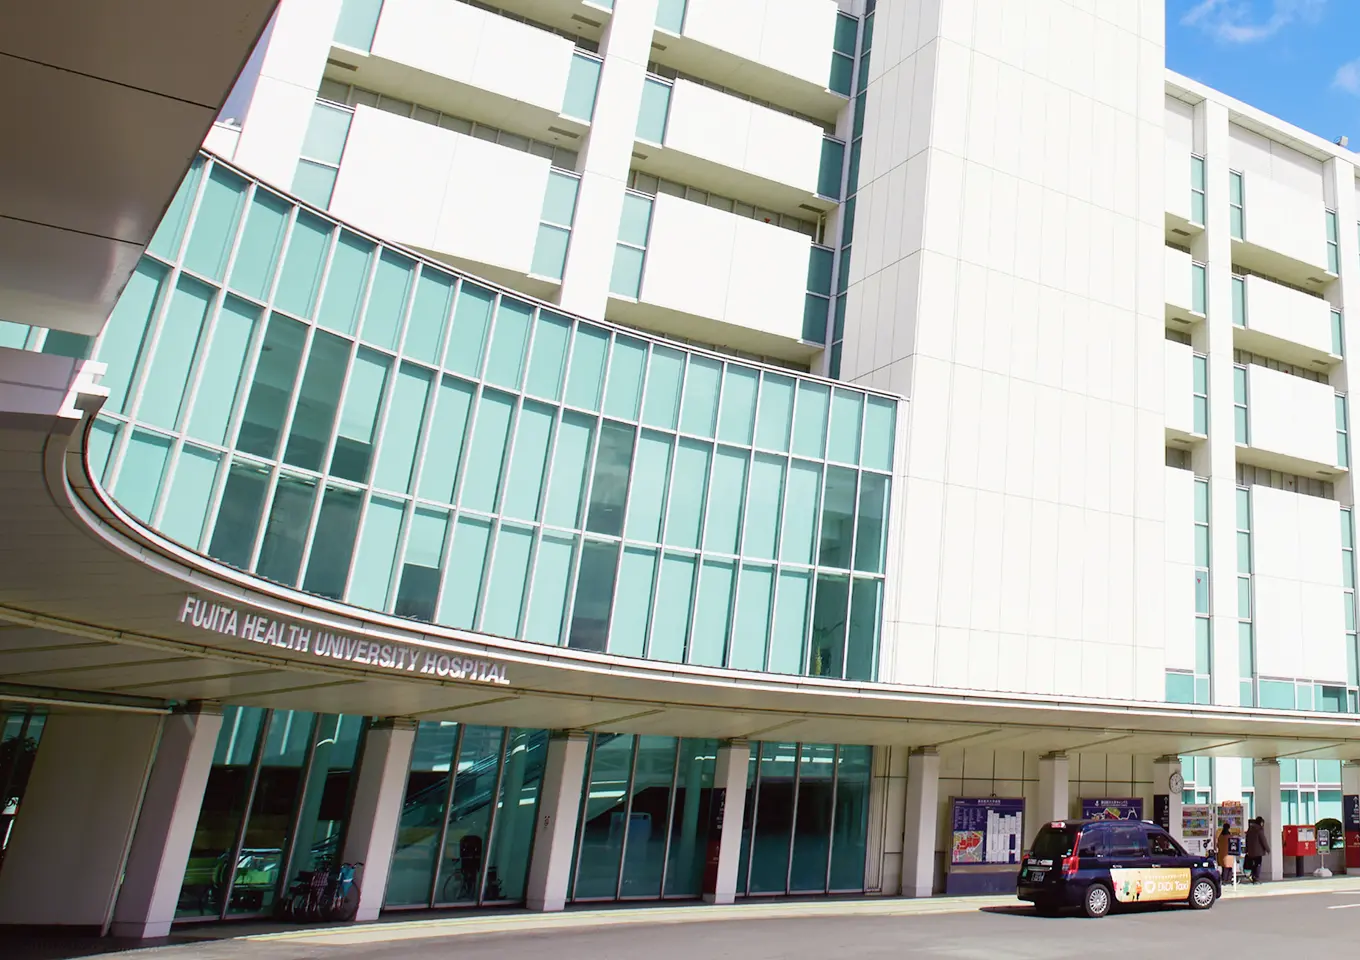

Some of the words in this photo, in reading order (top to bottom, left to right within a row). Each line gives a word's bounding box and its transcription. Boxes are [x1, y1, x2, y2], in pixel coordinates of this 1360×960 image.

[180, 596, 238, 636] FUJITA
[241, 614, 312, 652] HEALTH
[314, 631, 420, 671] UNIVERSITY
[420, 652, 510, 685] HOSPITAL
[1175, 880, 1189, 891] Taxi
